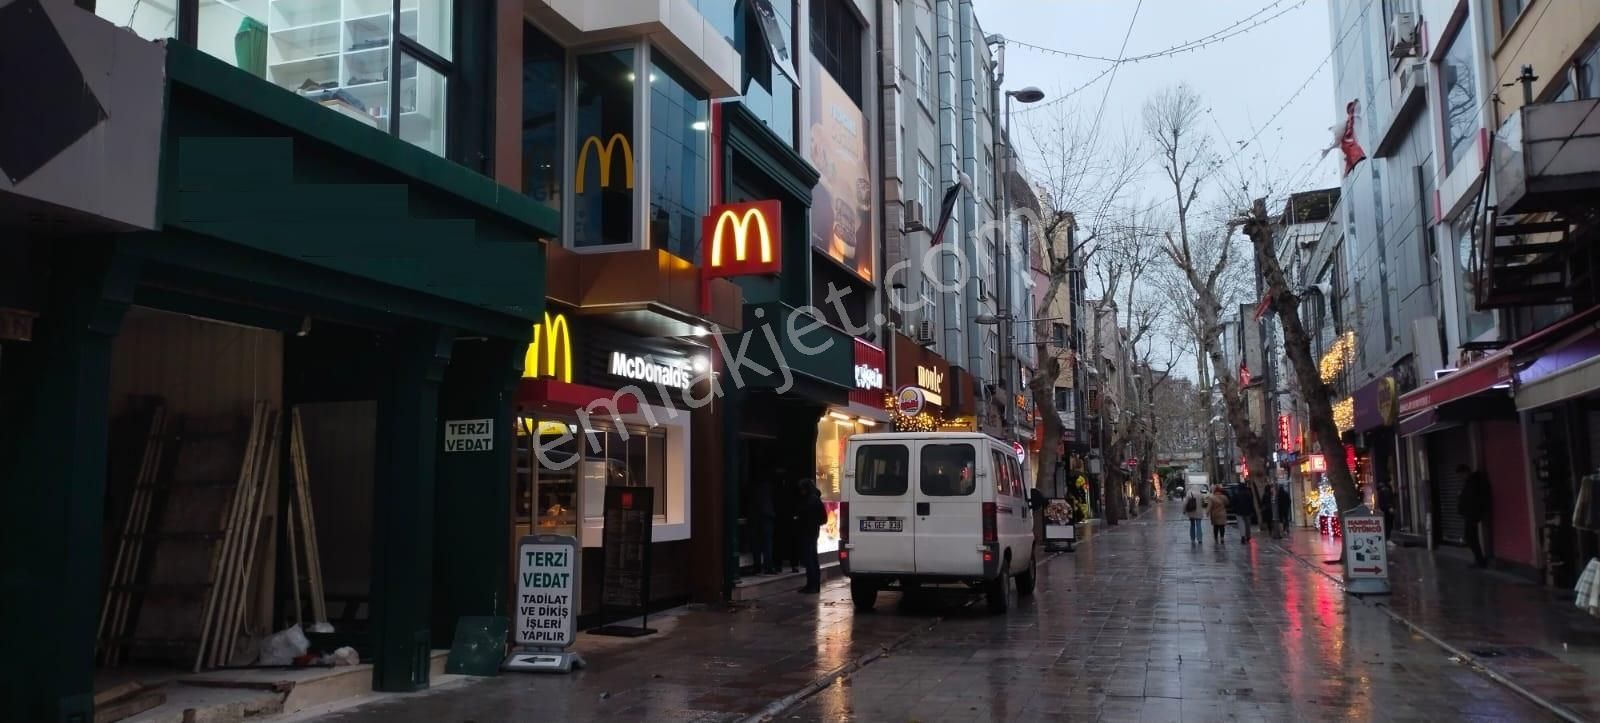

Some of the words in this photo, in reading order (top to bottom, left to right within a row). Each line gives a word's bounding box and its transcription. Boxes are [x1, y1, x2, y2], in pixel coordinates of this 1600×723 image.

[612, 351, 690, 389] McDonald's
[449, 420, 489, 435] TERZİ
[446, 438, 492, 451] VEDAT
[526, 548, 568, 567] TERZİ
[523, 573, 569, 588] VEDAT
[522, 593, 568, 604] TADİLAT
[521, 606, 535, 616] VE
[539, 605, 568, 619] DİKİŞ
[526, 617, 562, 629] İŞLERİ
[522, 631, 564, 641] YAPILIR
